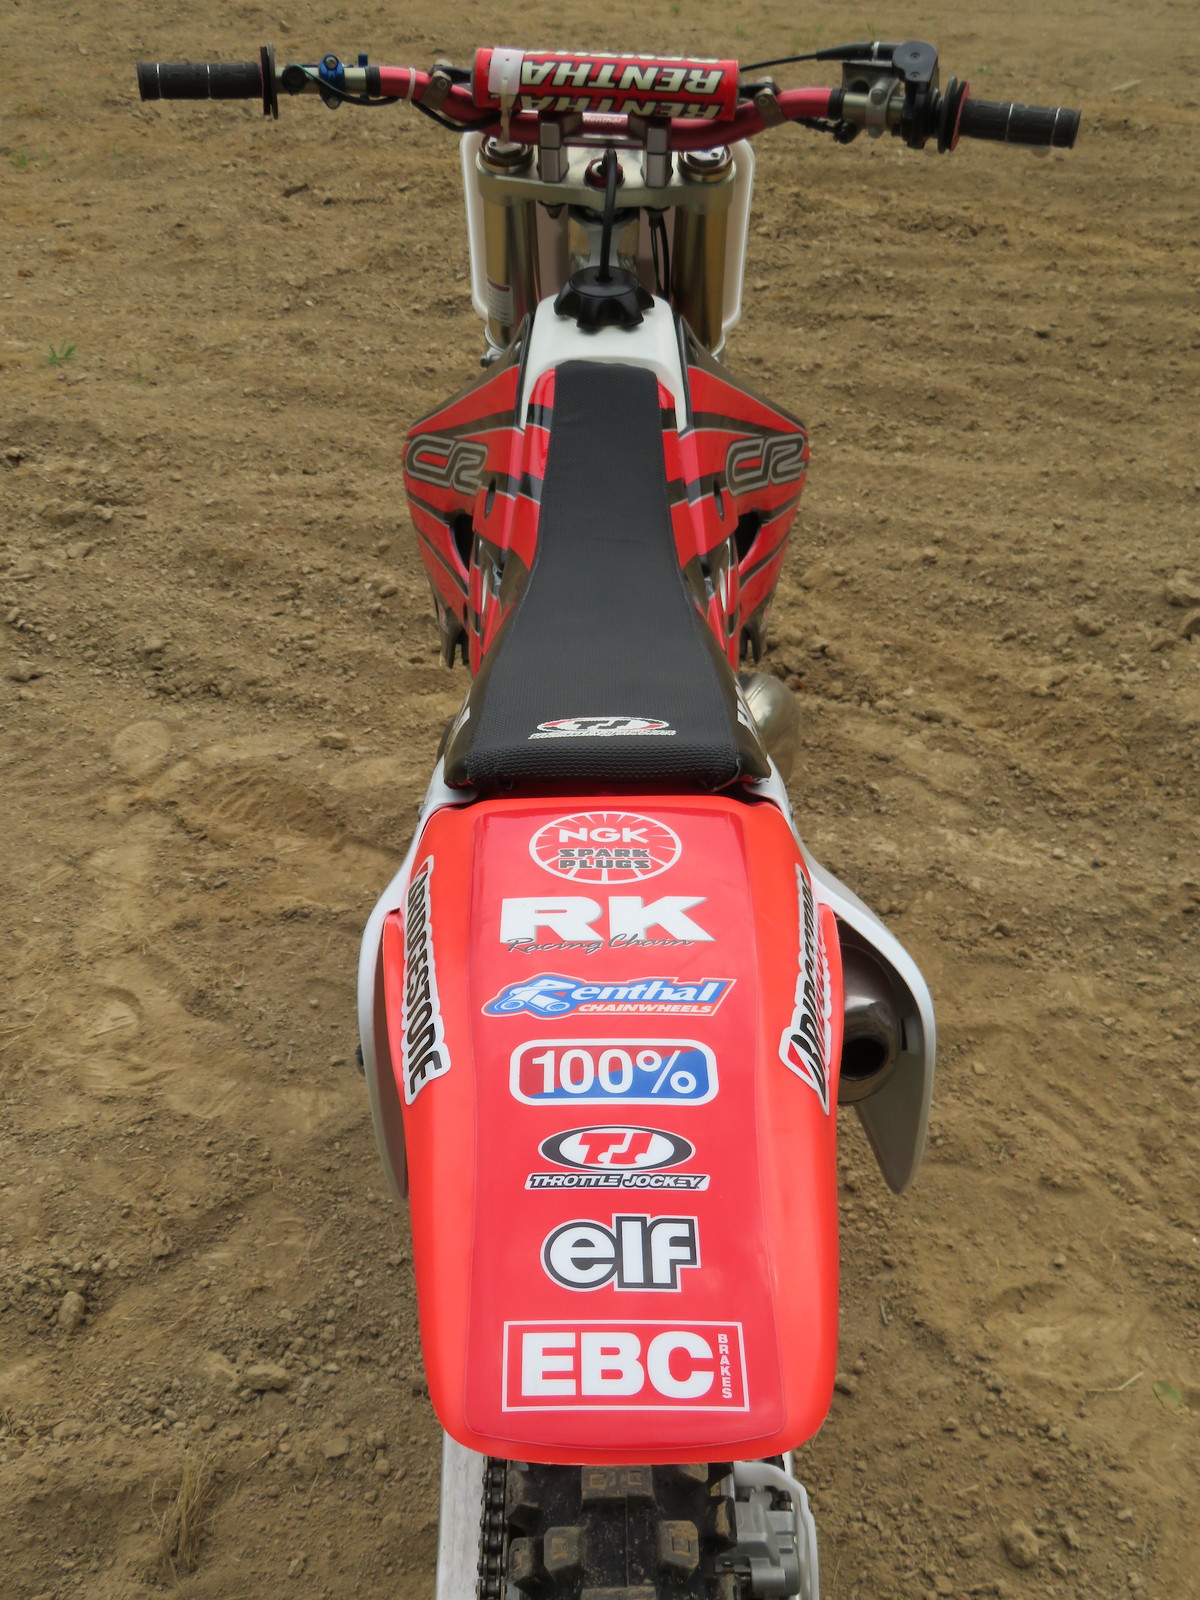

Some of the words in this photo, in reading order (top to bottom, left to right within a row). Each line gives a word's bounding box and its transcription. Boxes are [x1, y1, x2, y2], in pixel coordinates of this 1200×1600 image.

[404, 434, 488, 495] CR
[725, 433, 808, 497] CR
[557, 847, 651, 859] SPARK
[558, 827, 650, 843] NGK
[557, 858, 652, 870] PLUGS
[500, 896, 717, 943] RK
[506, 936, 606, 955] Racing
[607, 932, 695, 949] Chain
[406, 870, 443, 1096] BRIDGESTONE
[578, 1003, 713, 1014] CHAINWHEELS
[531, 1048, 697, 1095] 100%
[577, 1132, 654, 1165] TJ
[529, 1173, 622, 1189] THROTTLE
[622, 1174, 703, 1189] JOCKEY
[544, 1217, 697, 1287] elf
[521, 1330, 715, 1399] EBC
[717, 1333, 733, 1399] BRAKES
